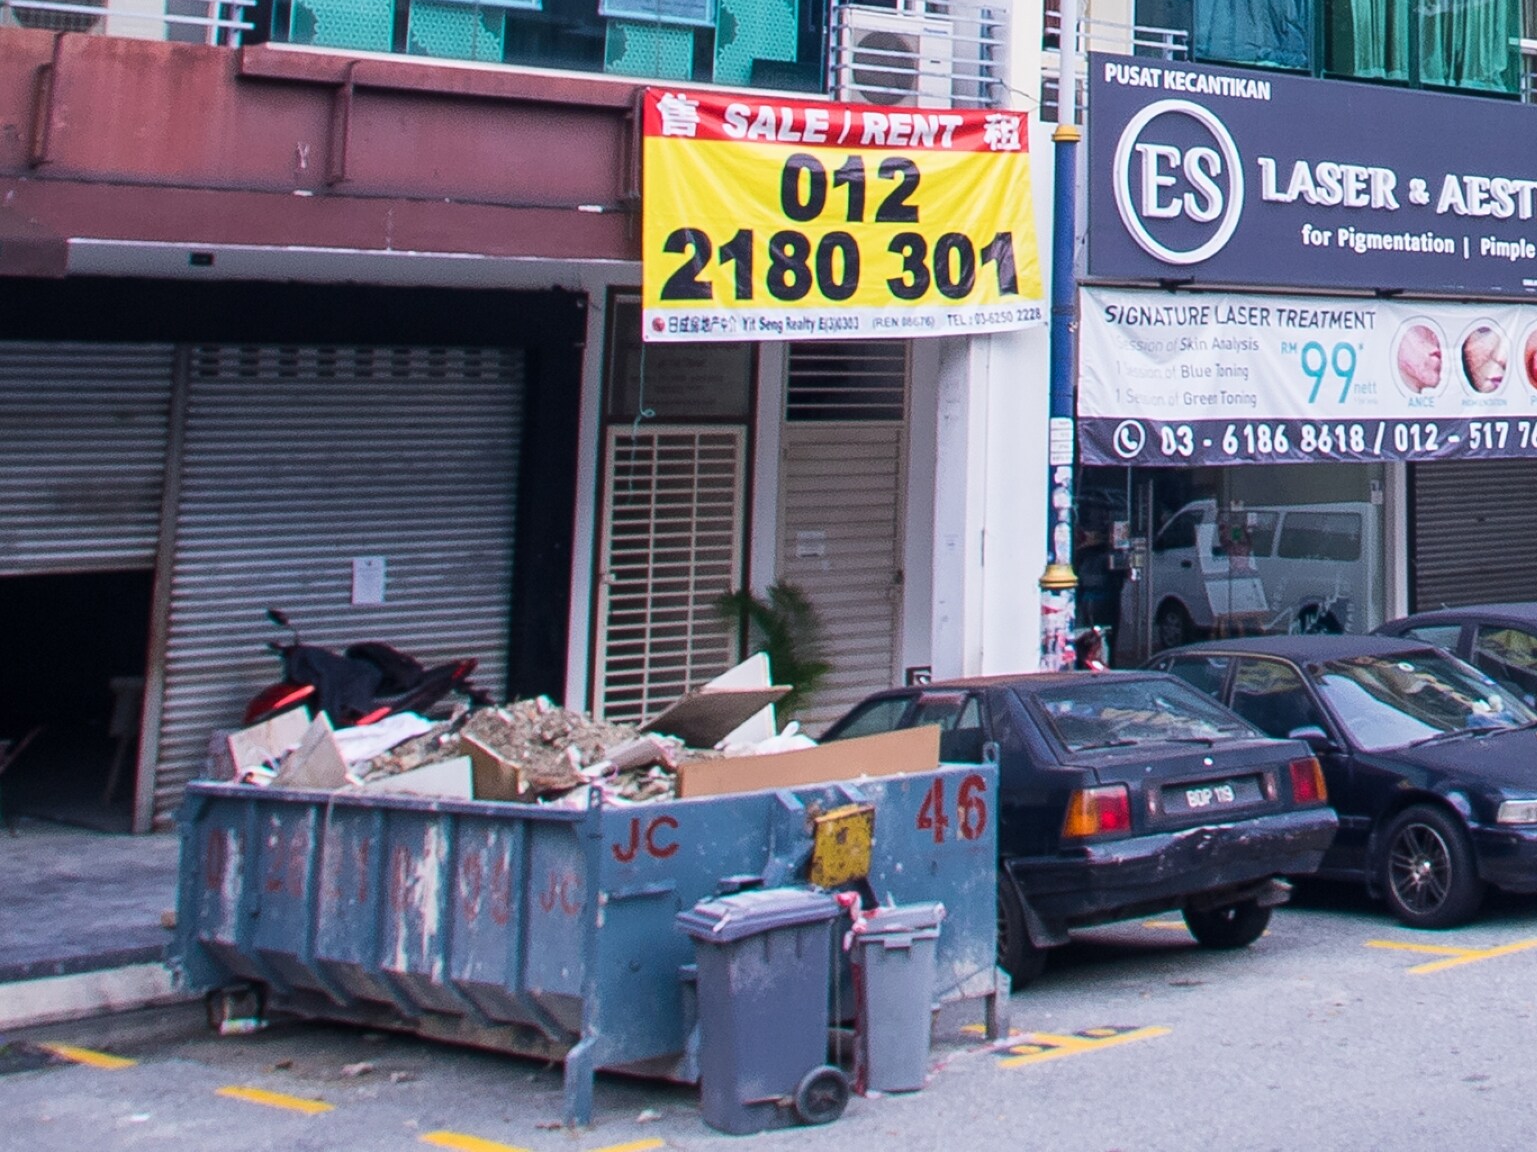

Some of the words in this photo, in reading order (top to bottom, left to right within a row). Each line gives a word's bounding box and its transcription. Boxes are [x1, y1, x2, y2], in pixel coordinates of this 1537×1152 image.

[1104, 64, 1162, 91] PUSAT
[1163, 69, 1272, 102] KECANTIKAN
[656, 92, 699, 138] 售
[722, 103, 830, 144] SALE
[860, 113, 963, 147] RENT
[983, 113, 1021, 151] 租
[780, 154, 921, 223] 012
[1135, 143, 1222, 224] ES
[1257, 156, 1400, 211] LASER
[1408, 178, 1431, 206] &
[1301, 223, 1331, 247] for
[1337, 226, 1455, 256] Pigmentation
[1480, 237, 1536, 261] Pimple
[660, 228, 860, 302] 2180
[886, 232, 1019, 301] 301
[758, 316, 783, 333] Seng
[786, 316, 815, 333] Realty
[947, 314, 965, 326] TEL
[1016, 308, 1042, 322] 2228
[1104, 305, 1210, 326] SIGNATURE
[1214, 307, 1271, 327] LASER
[1276, 308, 1376, 330] TREATMENT
[1180, 336, 1208, 351] Skin
[1181, 365, 1211, 378] Blue
[1281, 341, 1297, 355] RM
[1300, 340, 1358, 404] 99
[1221, 390, 1257, 407] Toning
[1408, 396, 1435, 408] ANCE
[1161, 425, 1194, 456] 03
[1222, 424, 1289, 455] 6186
[1300, 422, 1365, 454] 8618
[1394, 422, 1438, 452] 012
[1469, 421, 1509, 449] 517
[916, 774, 987, 844] 46
[612, 816, 680, 863] JC
[540, 870, 582, 917] JC
